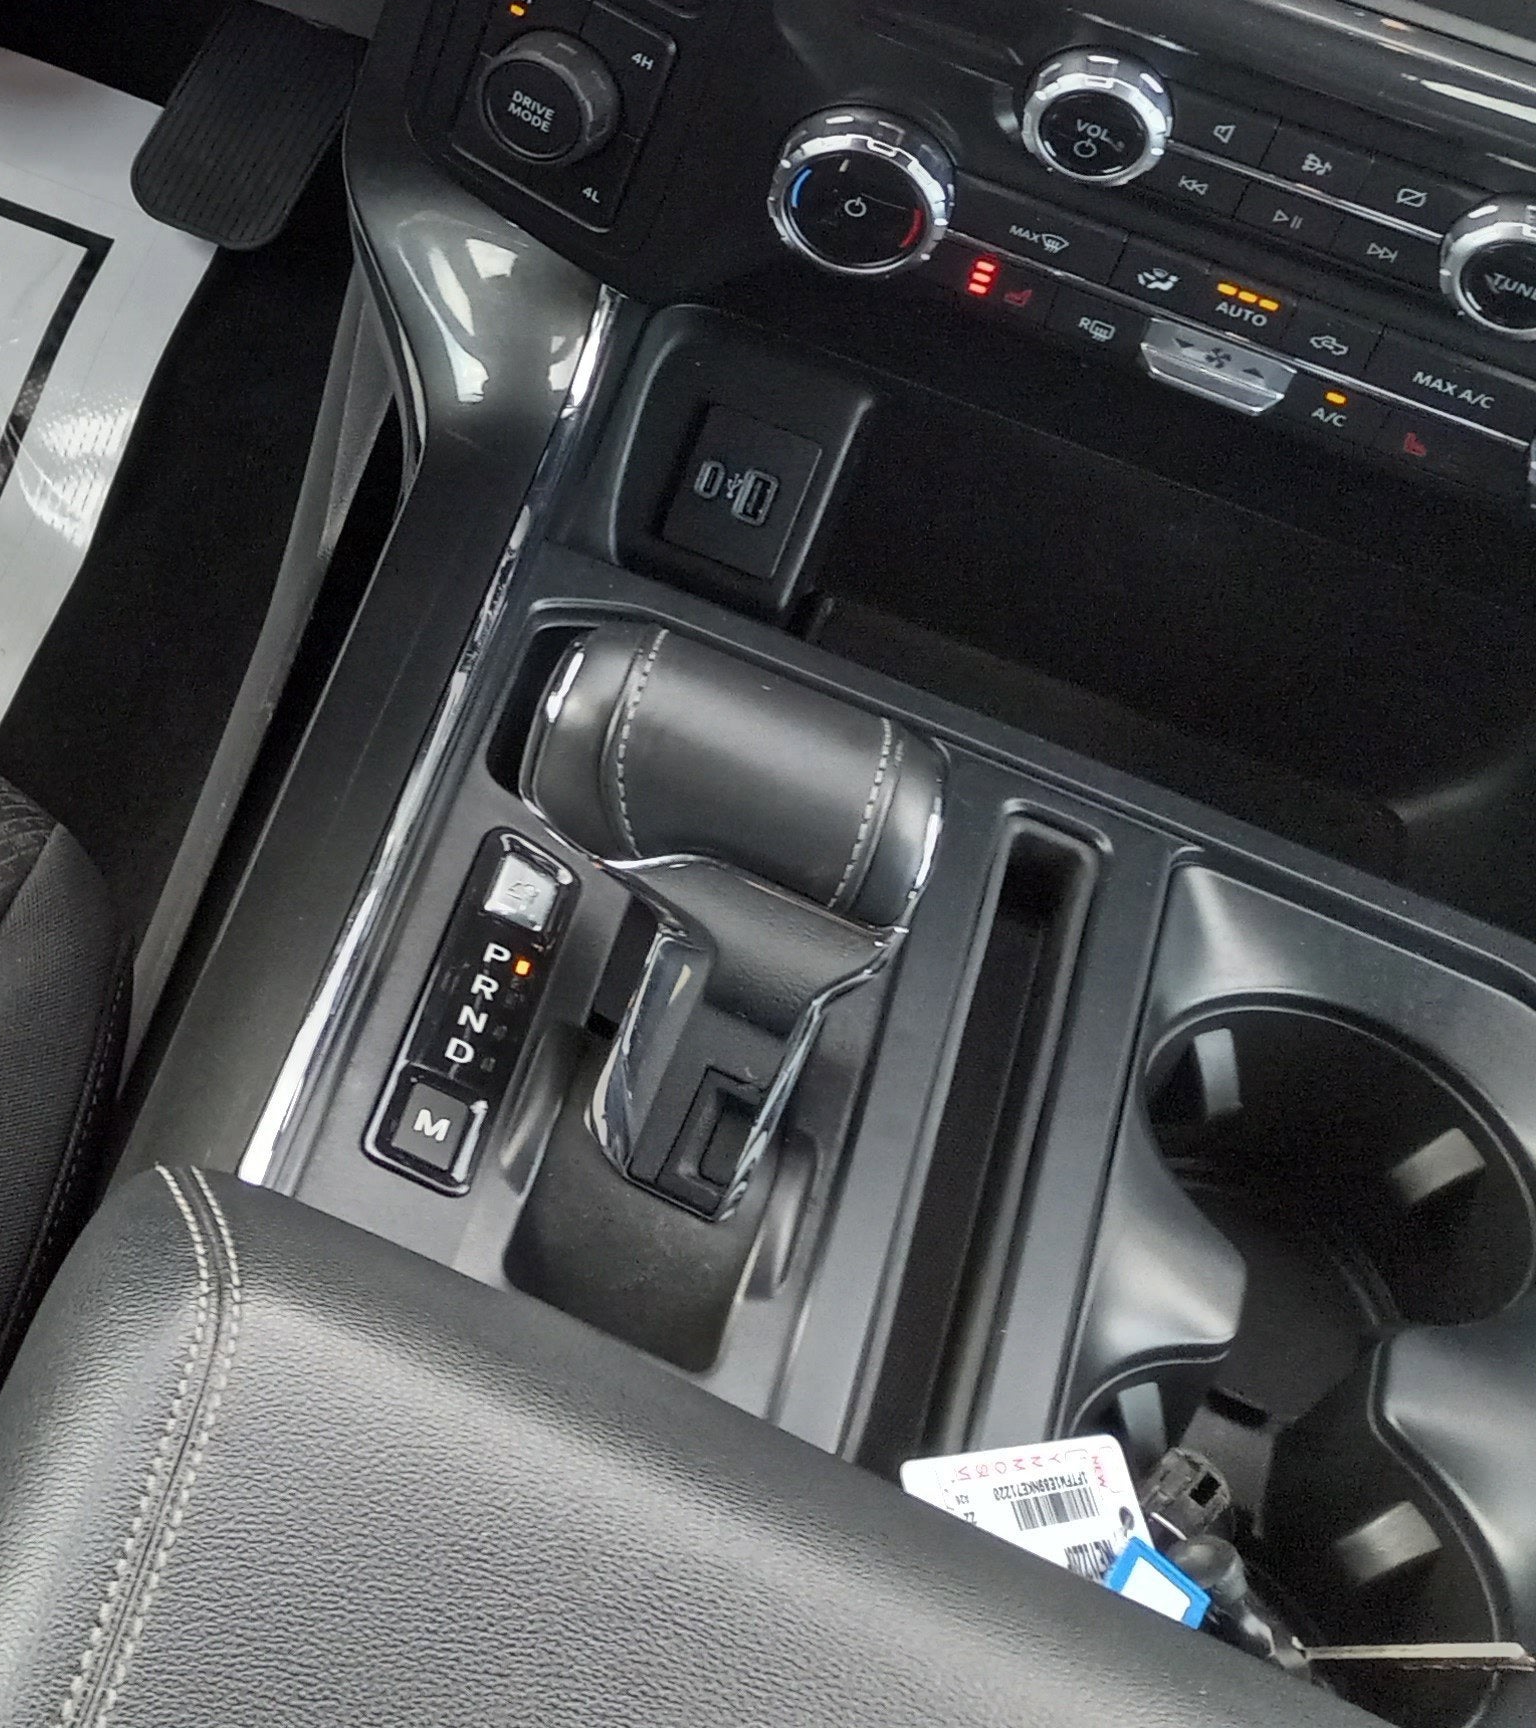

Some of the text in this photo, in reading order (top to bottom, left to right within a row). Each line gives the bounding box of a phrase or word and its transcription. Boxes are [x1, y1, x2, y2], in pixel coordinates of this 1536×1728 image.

[630, 52, 655, 71] 4H
[507, 102, 551, 134] MODE
[511, 90, 556, 122] DRIVE
[1075, 118, 1110, 143] VOL
[581, 186, 601, 204] 4L
[1009, 224, 1040, 244] MAX
[1079, 316, 1091, 330] R
[1215, 300, 1268, 328] AUTO
[1411, 371, 1496, 410] MAX A/C
[1311, 406, 1348, 428] A/C
[484, 941, 511, 965] P
[470, 974, 499, 1001] R
[457, 1005, 489, 1035] N
[444, 1037, 475, 1064] D
[413, 1109, 451, 1142] M
